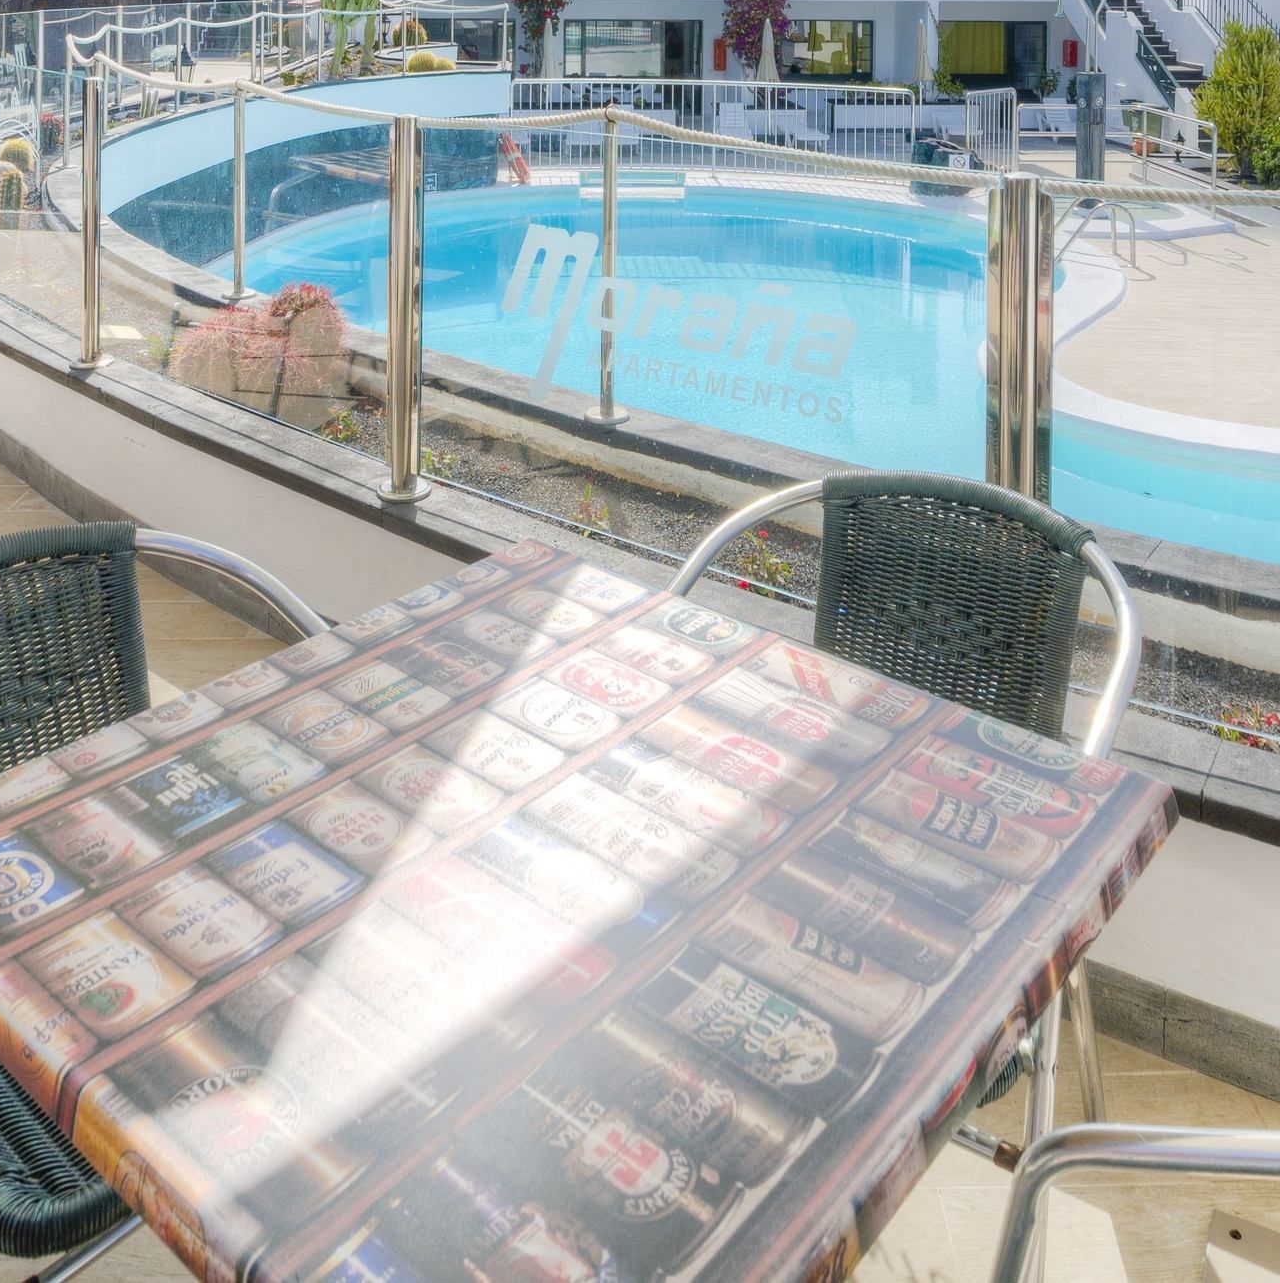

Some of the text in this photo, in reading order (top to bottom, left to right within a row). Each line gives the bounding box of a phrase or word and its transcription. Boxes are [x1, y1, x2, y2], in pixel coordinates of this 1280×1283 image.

[588, 347, 847, 425] APARTAMENTOS
[293, 709, 357, 742] Buckler
[147, 769, 221, 809] Light
[158, 760, 206, 787] ale
[691, 981, 777, 1051] BRASS
[729, 1003, 794, 1057] TOP
[542, 1097, 610, 1154] EXTRA
